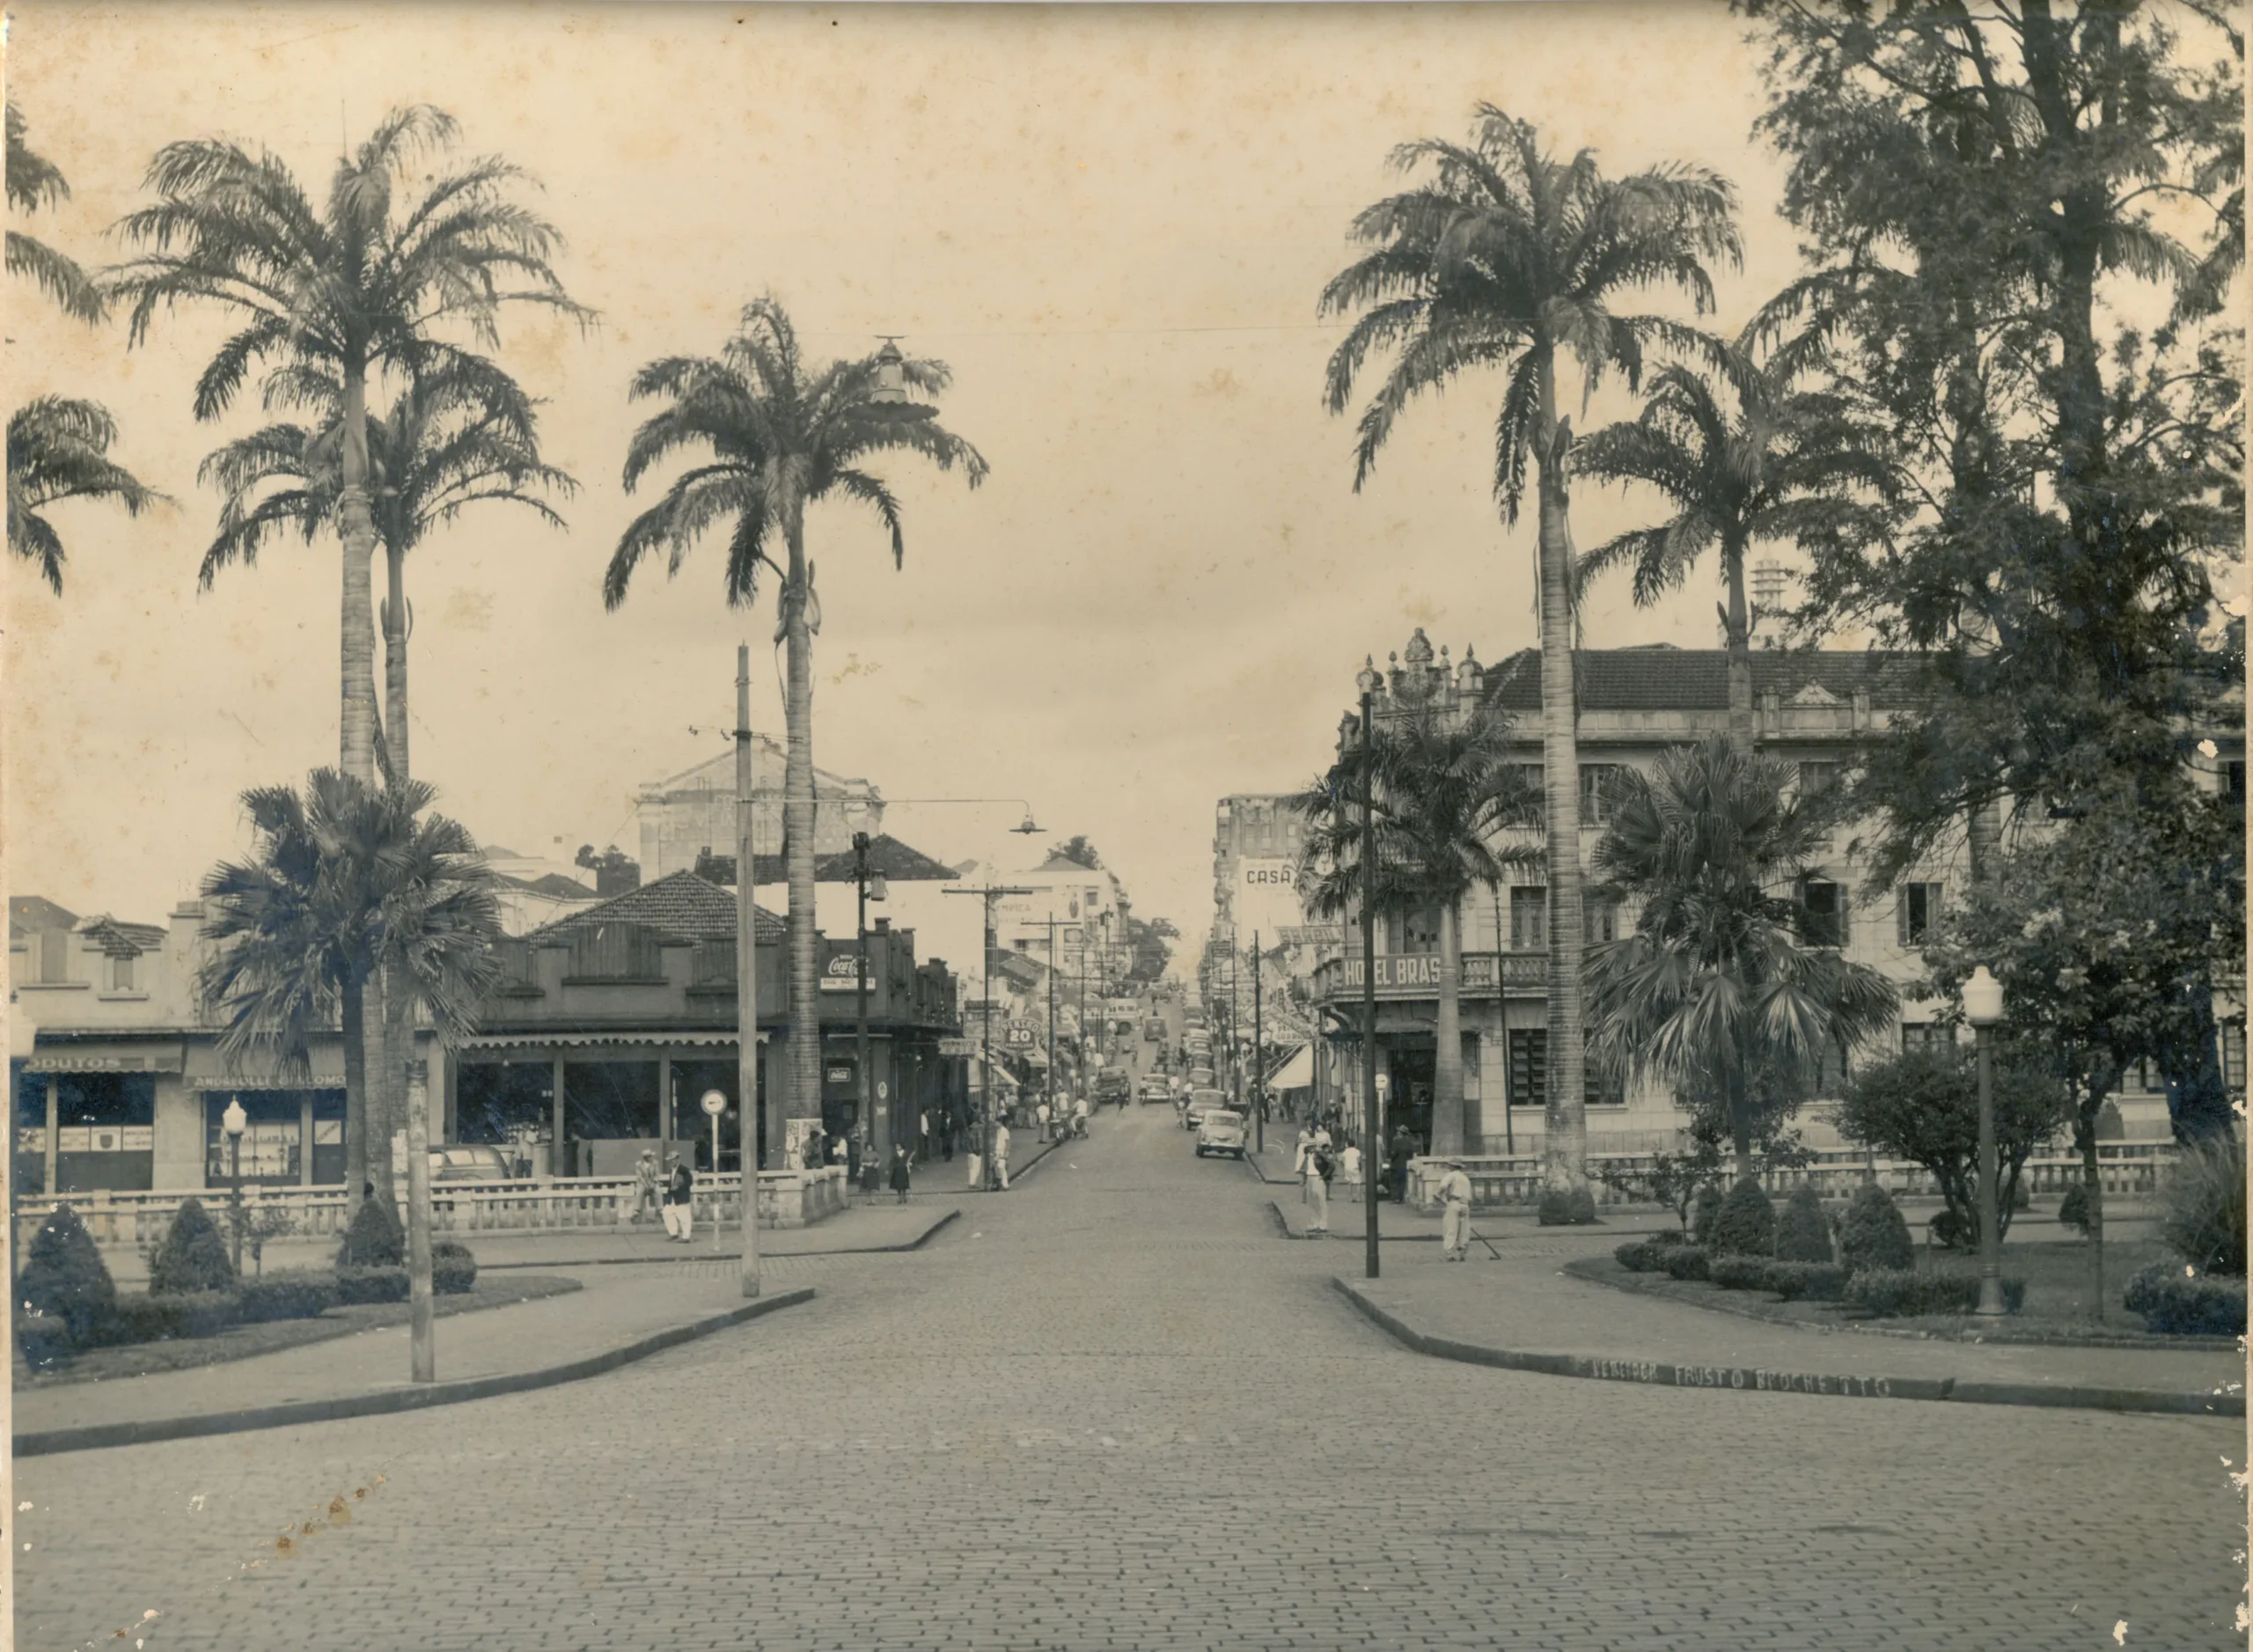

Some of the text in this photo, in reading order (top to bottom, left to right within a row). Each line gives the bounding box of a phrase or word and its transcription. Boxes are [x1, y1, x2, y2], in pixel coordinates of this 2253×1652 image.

[1246, 870, 1291, 885] CASA
[1345, 957, 1441, 985] HOEL BRAS
[1009, 1030, 1031, 1042] 20
[1675, 1365, 1744, 1389] FAUSTO
